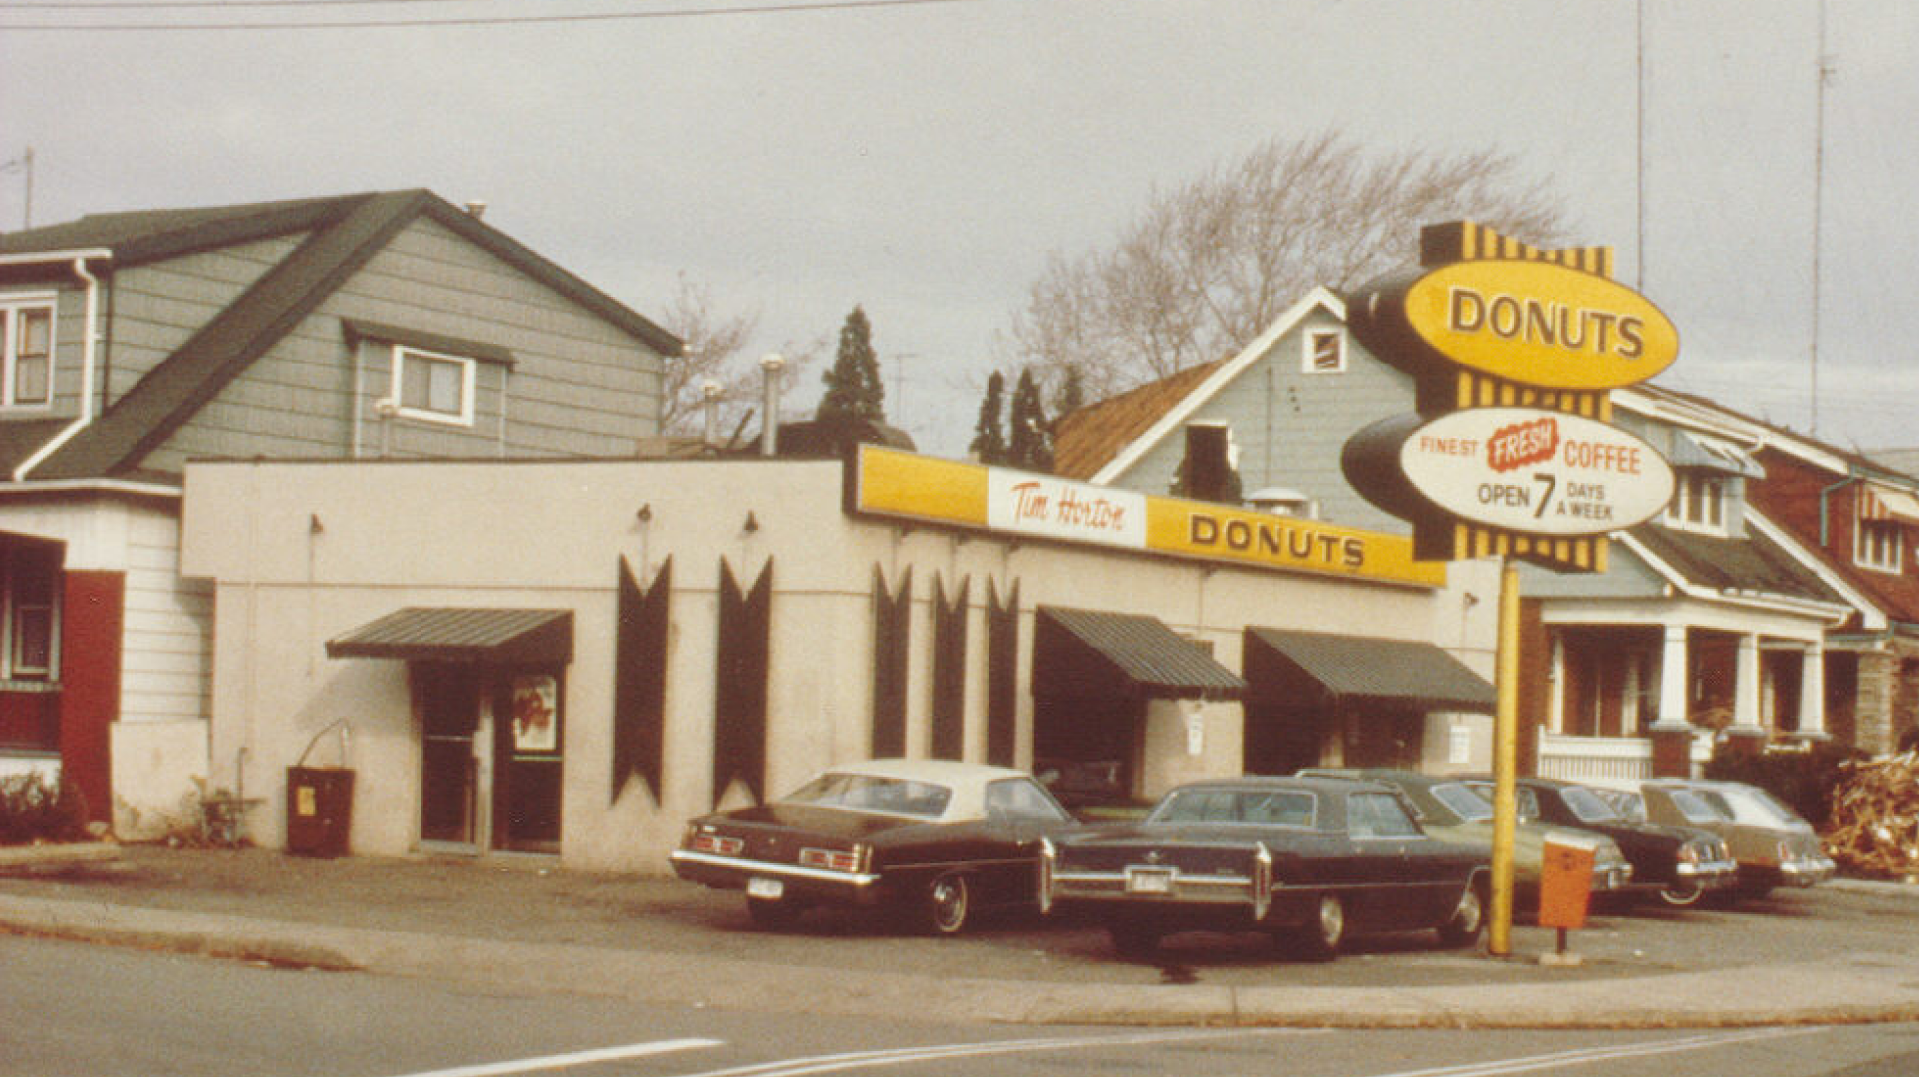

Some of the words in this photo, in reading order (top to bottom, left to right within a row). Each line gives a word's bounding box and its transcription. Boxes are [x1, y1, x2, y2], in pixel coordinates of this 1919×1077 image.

[1450, 287, 1644, 358] DONUTS
[1420, 436, 1479, 456] FINEST
[1494, 424, 1552, 464] FRESH
[1564, 440, 1641, 474] COFFEE
[1011, 481, 1049, 521] Tim
[1057, 489, 1124, 531] Horton
[1478, 483, 1530, 507] OPEN
[1533, 473, 1556, 518] 7
[1566, 482, 1605, 501] DAYS
[1556, 498, 1566, 516] A
[1570, 500, 1613, 520] WEEK
[1191, 514, 1365, 566] DONUTS
